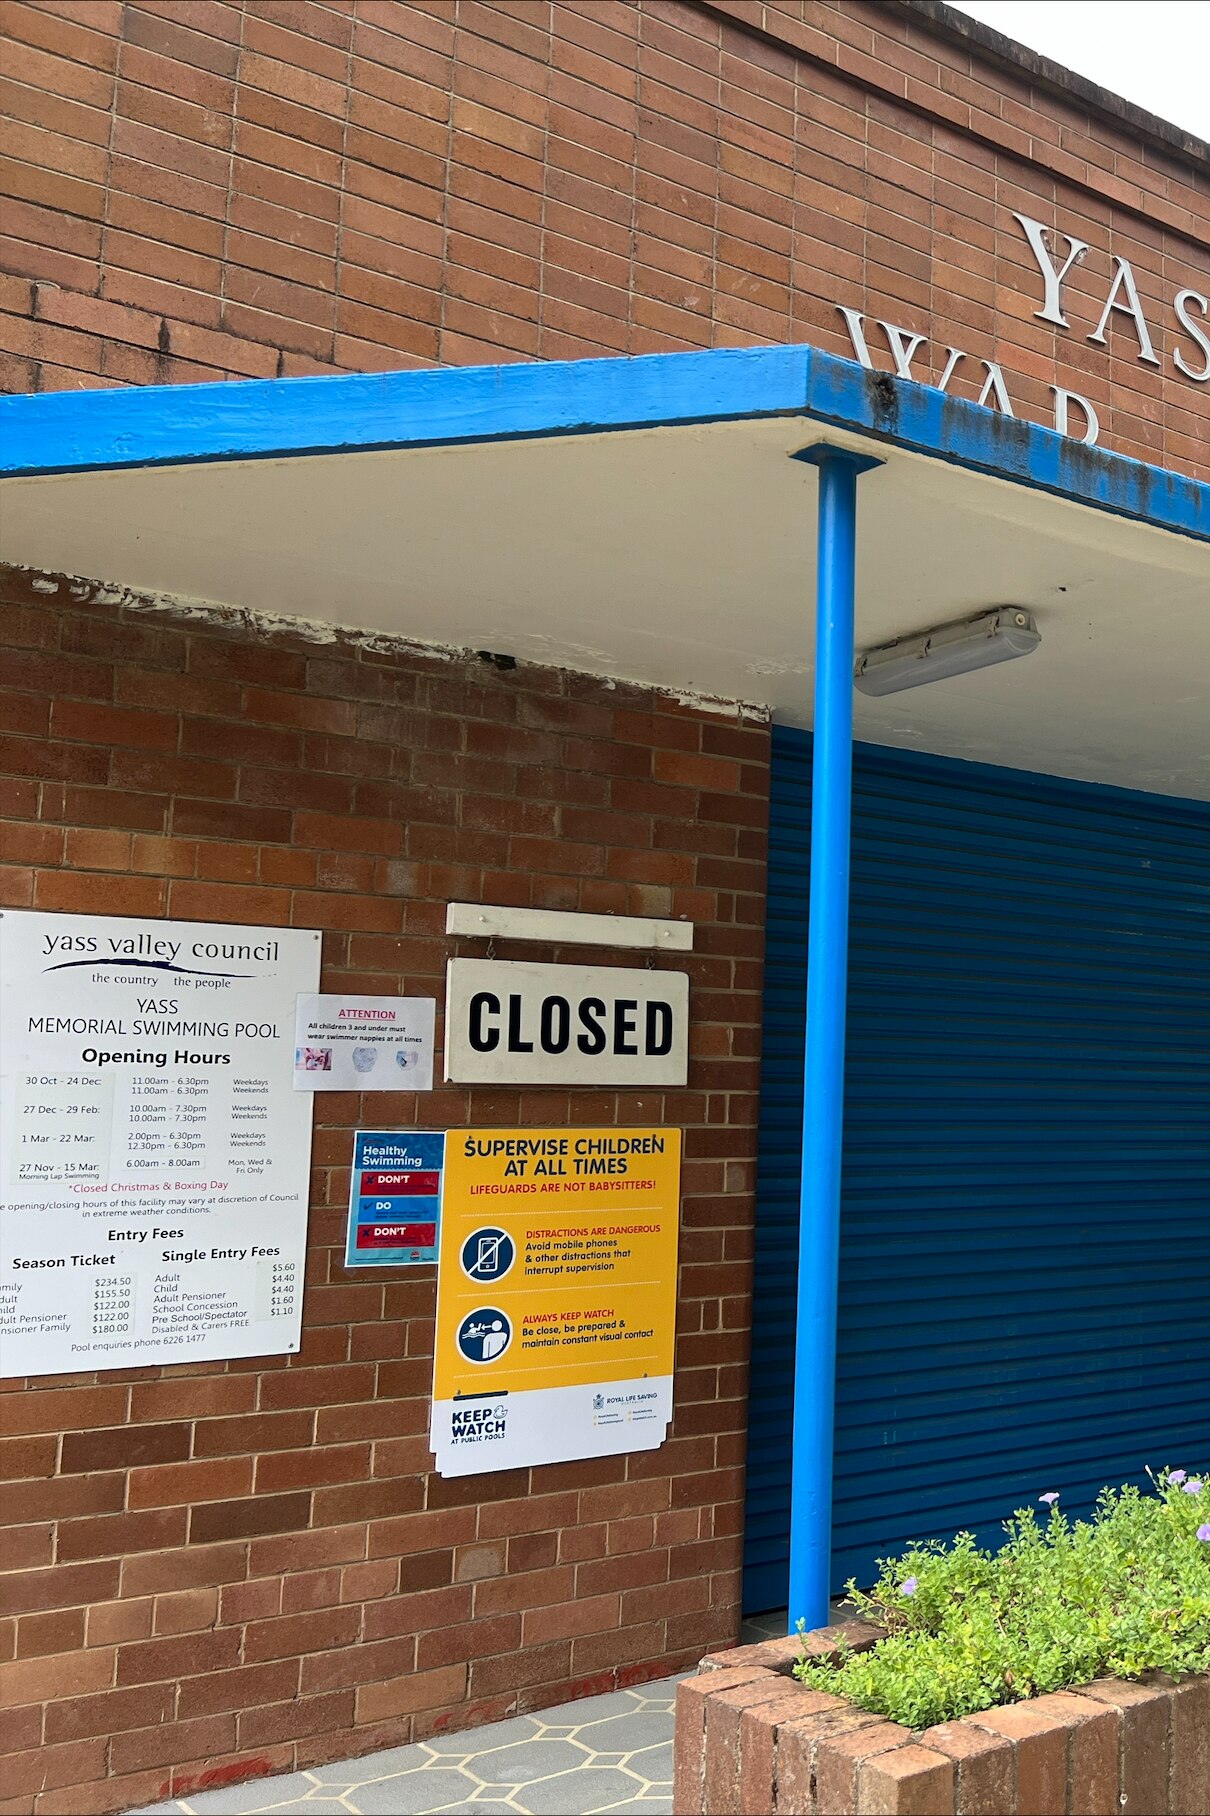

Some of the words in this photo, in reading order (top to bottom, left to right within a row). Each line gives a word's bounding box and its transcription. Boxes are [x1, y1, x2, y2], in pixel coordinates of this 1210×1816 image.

[44, 935, 97, 955] yass
[109, 934, 181, 961] valley
[192, 942, 278, 961] council
[93, 973, 109, 983] the
[115, 976, 157, 986] country
[174, 977, 191, 986] the
[196, 979, 230, 989] people
[137, 999, 178, 1014] YASS
[339, 1009, 396, 1019] ATTENTION
[29, 1018, 126, 1034] MEMORIAL
[133, 1020, 228, 1036] SWIMMING
[236, 1023, 280, 1038] POOL
[469, 992, 673, 1055] CLOSED
[82, 1048, 167, 1067] Opening
[175, 1051, 231, 1064] Hours
[178, 1078, 208, 1086] 6.30pm
[234, 1079, 268, 1087] Weekdays
[363, 1146, 407, 1156] Healthy
[464, 1140, 568, 1157] SUPERVISE
[575, 1138, 664, 1155] CHILDREN
[363, 1156, 422, 1167] Swimming
[504, 1160, 528, 1176] AT
[534, 1160, 567, 1175] ALL
[574, 1158, 627, 1174] TIMES
[111, 1184, 159, 1192] Christmas
[175, 1182, 207, 1191] Boxing
[210, 1181, 228, 1190] Day
[470, 1184, 537, 1194] LIFEGUARDS
[540, 1183, 560, 1192] ARE
[564, 1182, 586, 1192] NOT
[589, 1181, 656, 1190] BABYSITTERS!
[8, 1202, 79, 1211] opening/closing
[139, 1198, 166, 1207] facility
[109, 1230, 147, 1242] Entry
[153, 1229, 183, 1238] Fees
[374, 1228, 406, 1236] DON'T
[526, 1228, 588, 1238] DISTRACTIONS
[609, 1225, 660, 1234] DANGEROUS
[526, 1242, 550, 1251] Avoid
[554, 1240, 583, 1250] mobile
[586, 1239, 618, 1249] phones
[163, 1249, 206, 1263] Single
[212, 1249, 247, 1260] Entry
[252, 1246, 280, 1256] Fees
[526, 1255, 532, 1263] &
[536, 1254, 558, 1262] other
[562, 1251, 611, 1260] distractions
[13, 1259, 65, 1269] Season
[71, 1254, 115, 1266] Ticket
[525, 1265, 563, 1275] interrupt
[566, 1262, 614, 1273] supervision
[96, 1277, 131, 1287] $234.50
[0, 1295, 17, 1303] dult
[95, 1288, 130, 1299] $155.50
[20, 1315, 66, 1323] Pensioner
[94, 1312, 129, 1322] $122.00
[523, 1314, 557, 1323] ALWAYS
[560, 1312, 581, 1321] KEEP
[584, 1309, 614, 1319] WATCH
[0, 1325, 37, 1334] nsioner
[41, 1322, 70, 1332] Family
[93, 1324, 128, 1333] $180.00
[523, 1328, 533, 1336] Be
[537, 1326, 561, 1335] close,
[564, 1324, 575, 1332] be
[578, 1321, 616, 1333] prepared
[619, 1320, 625, 1328] &
[72, 1343, 90, 1351] Pool
[93, 1341, 131, 1350] enquiries
[135, 1339, 161, 1349] phone
[164, 1336, 183, 1345] 6226
[187, 1333, 205, 1343] 1477
[522, 1338, 559, 1348] maintain
[562, 1335, 597, 1345] constant
[599, 1332, 622, 1341] visual
[625, 1329, 654, 1339] contact
[452, 1409, 492, 1424] KEEP
[452, 1420, 505, 1437] WATCH
